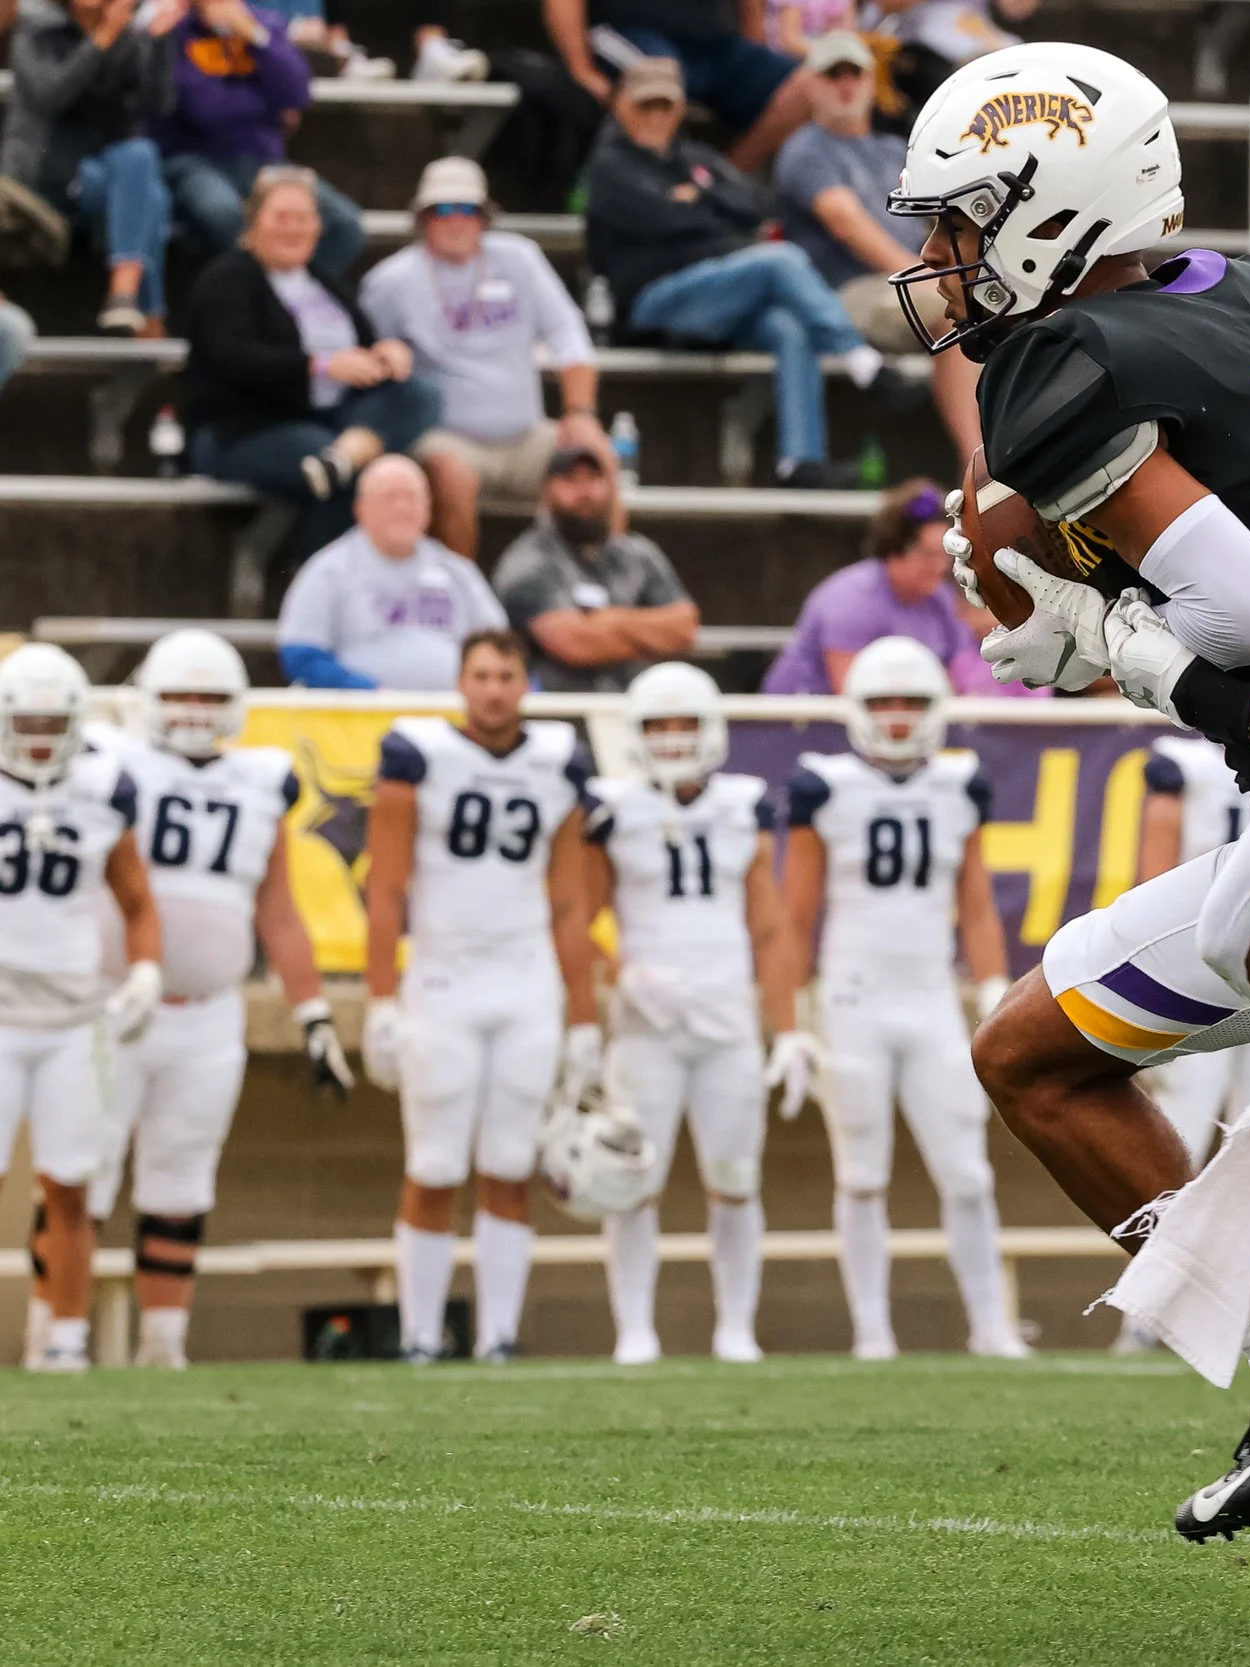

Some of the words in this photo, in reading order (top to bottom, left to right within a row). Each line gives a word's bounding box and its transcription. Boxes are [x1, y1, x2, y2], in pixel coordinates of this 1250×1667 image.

[0, 822, 80, 896] 36
[151, 795, 239, 873] 67
[448, 791, 540, 863] 83
[865, 817, 931, 888] 81
[665, 832, 713, 897] 11
